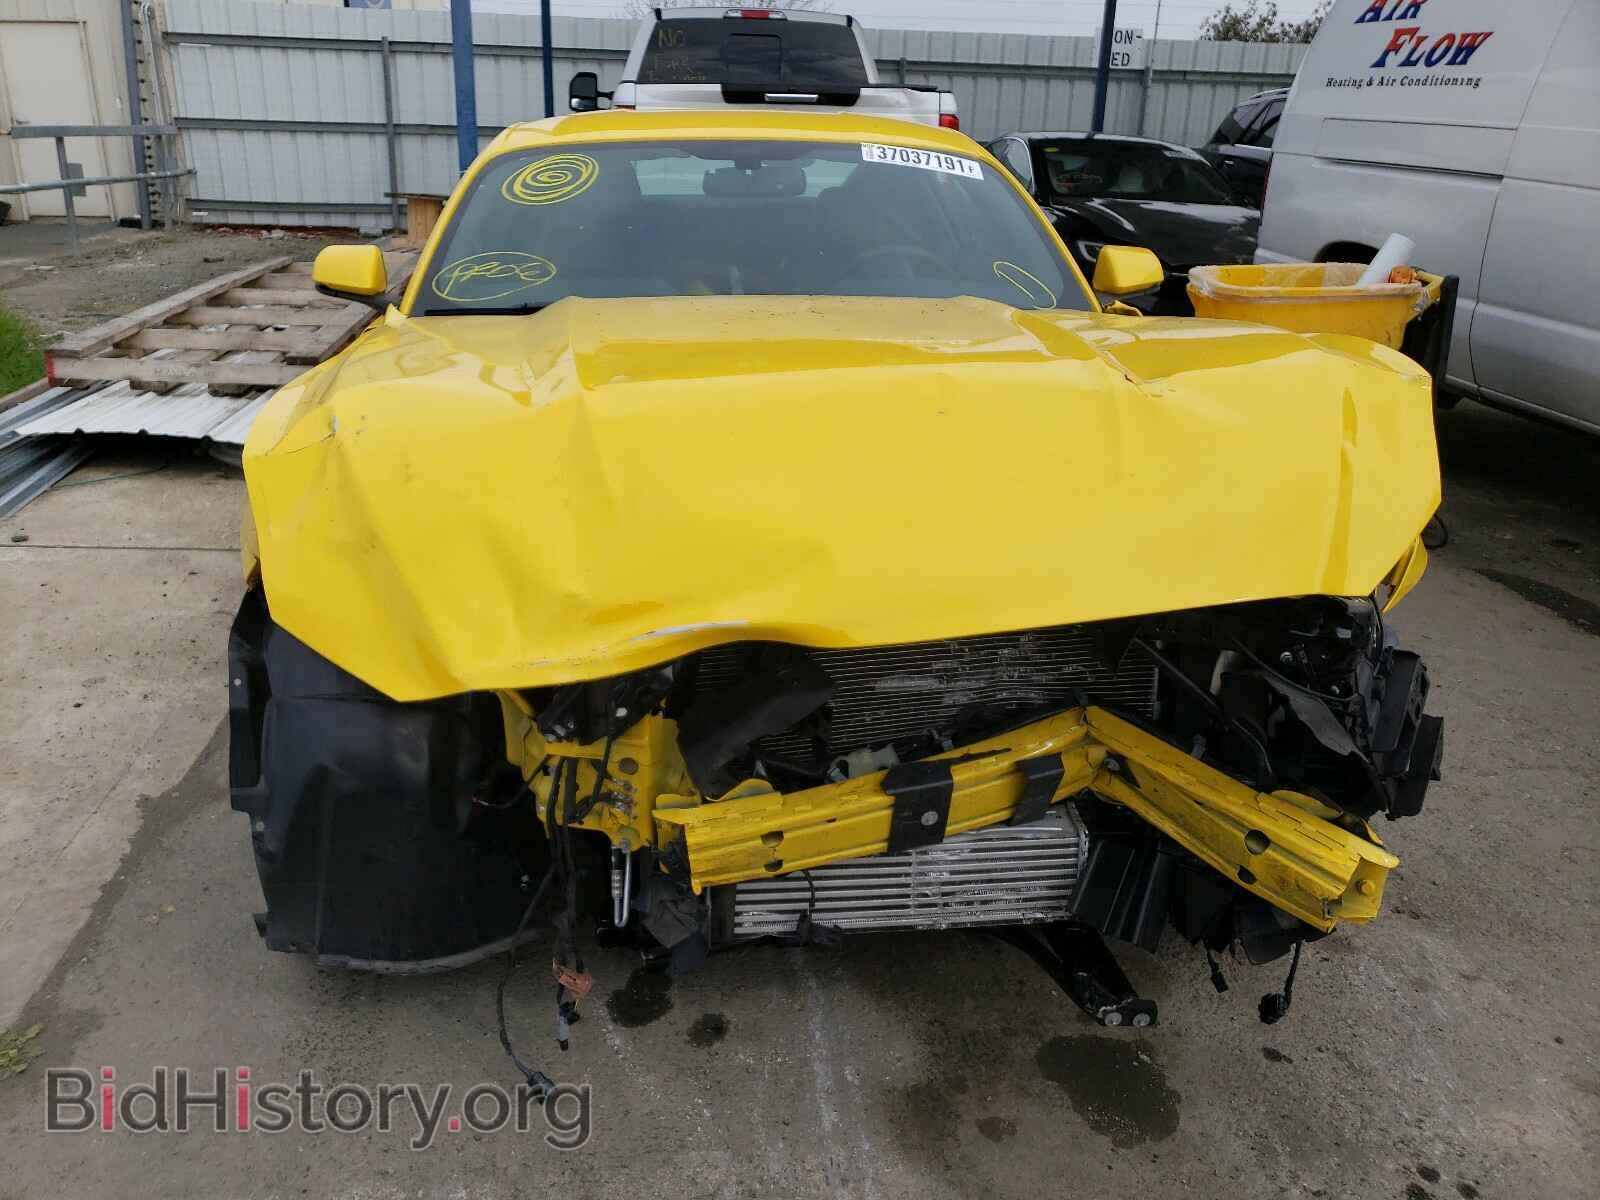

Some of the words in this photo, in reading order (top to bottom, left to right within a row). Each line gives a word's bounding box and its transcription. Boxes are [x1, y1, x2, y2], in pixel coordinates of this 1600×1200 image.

[1114, 30, 1143, 45] ON-
[1110, 52, 1130, 67] ED
[1325, 77, 1364, 89] Heating
[1366, 76, 1374, 87] &
[1377, 76, 1397, 87] Air
[1400, 75, 1482, 89] Conditioning
[876, 146, 965, 173] 37037191
